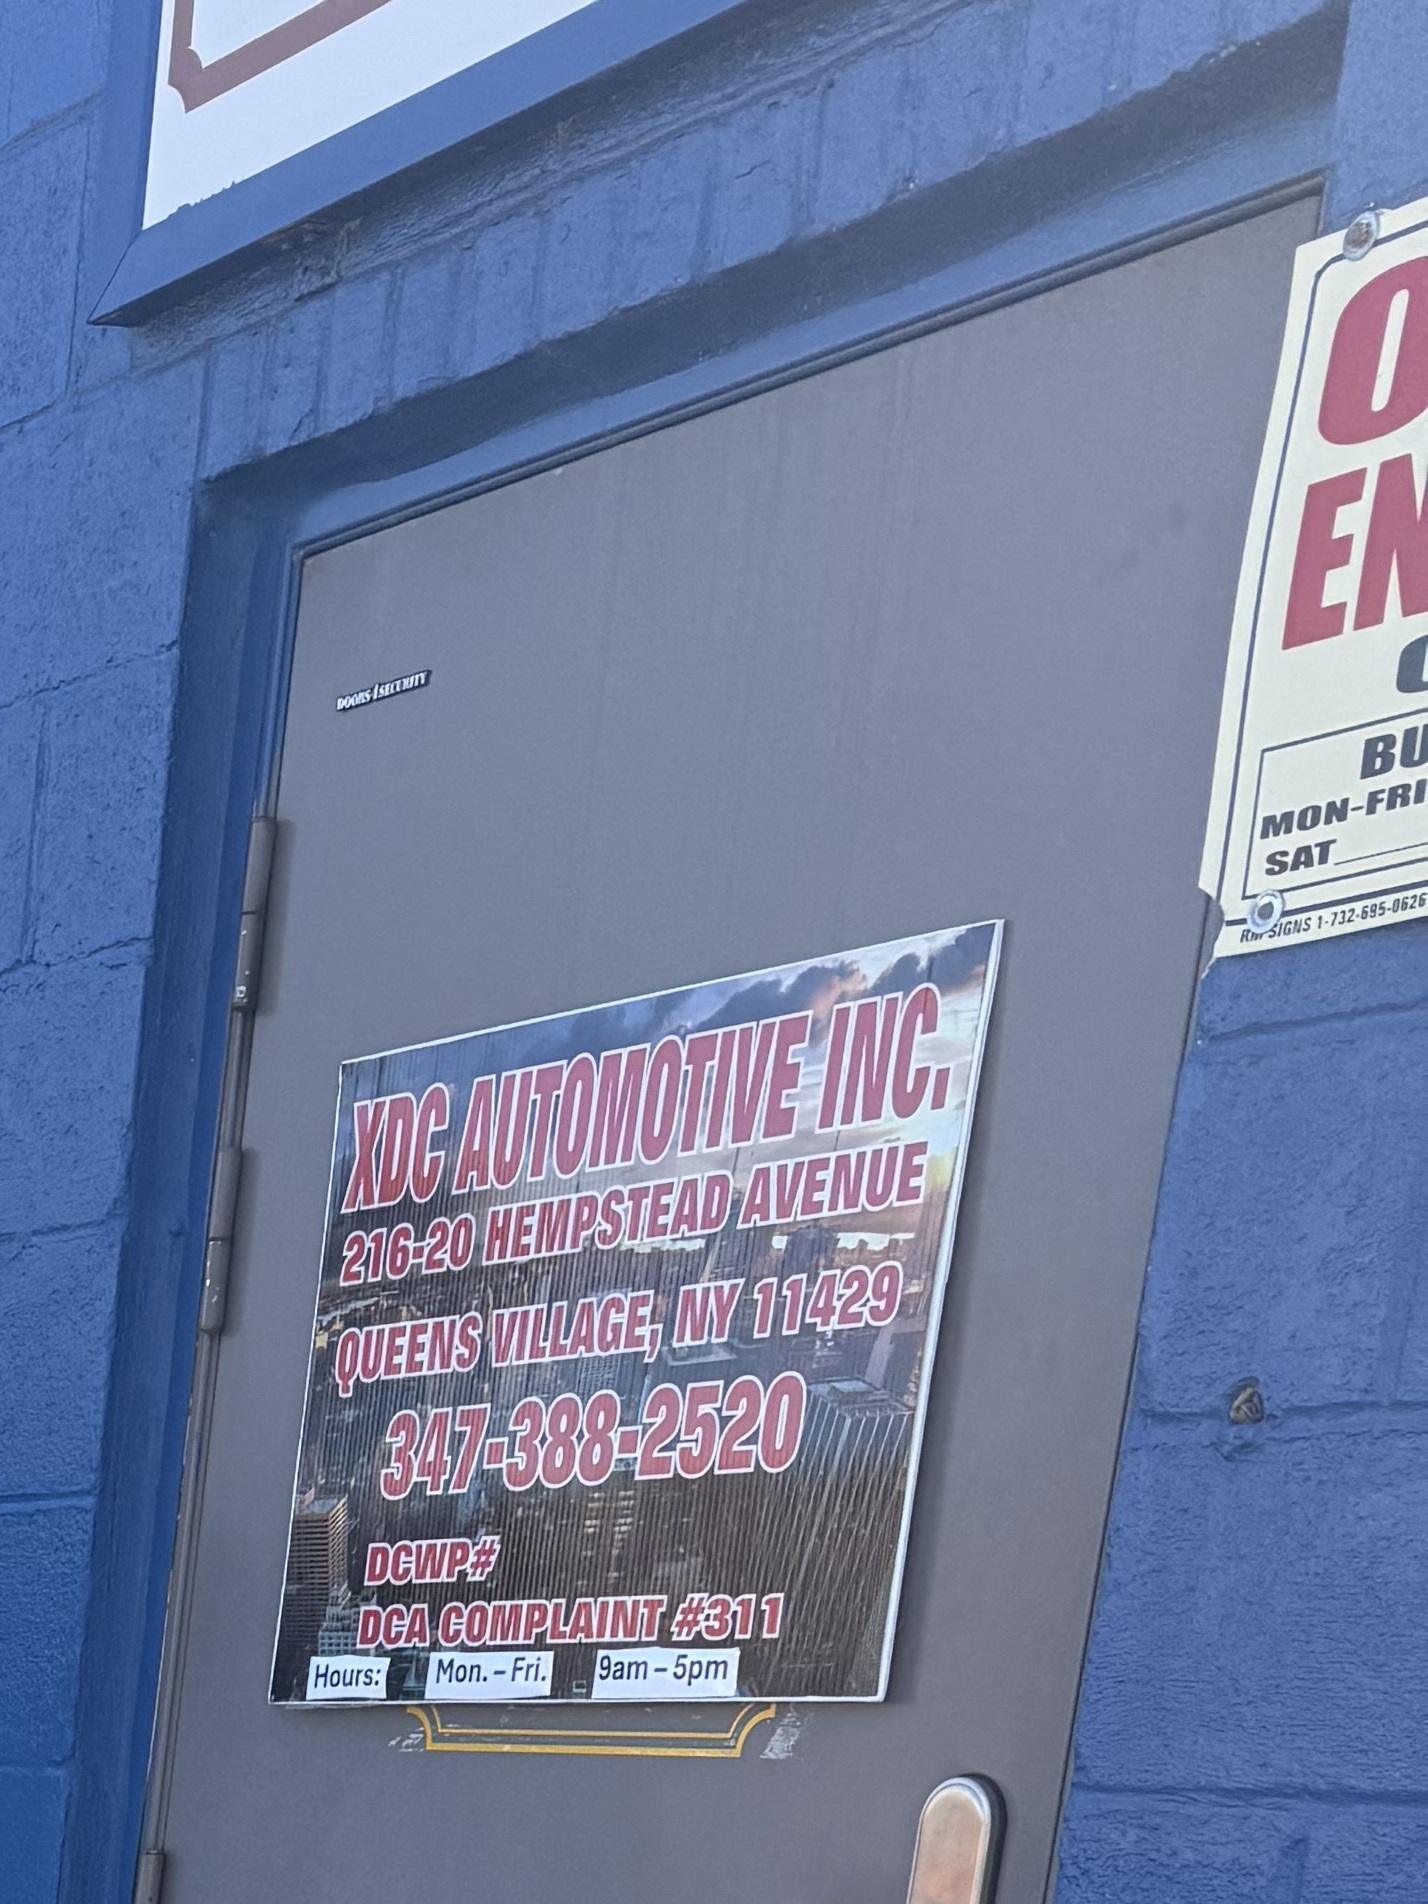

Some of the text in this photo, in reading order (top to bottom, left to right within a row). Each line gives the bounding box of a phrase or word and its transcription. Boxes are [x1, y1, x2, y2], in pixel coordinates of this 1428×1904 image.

[1265, 838, 1337, 876] SAT
[1268, 916, 1312, 938] SIGNS
[339, 982, 951, 1214] XDC AUTOMOTIVE INC.
[339, 1140, 928, 1286] 216-20 HEMPSTEAD AVENUE
[334, 1260, 905, 1398] QUEENS VILLAGE, NY 11429
[378, 1369, 808, 1501] 347-388-2520
[363, 1535, 501, 1587] DCWP#
[356, 1591, 786, 1649] DCA COMPLAINT #311
[313, 1663, 382, 1689] Hours:
[435, 1656, 489, 1684] Mon.
[511, 1656, 547, 1683] Fri.
[599, 1654, 648, 1681] 9am
[672, 1653, 729, 1687] 5pm
